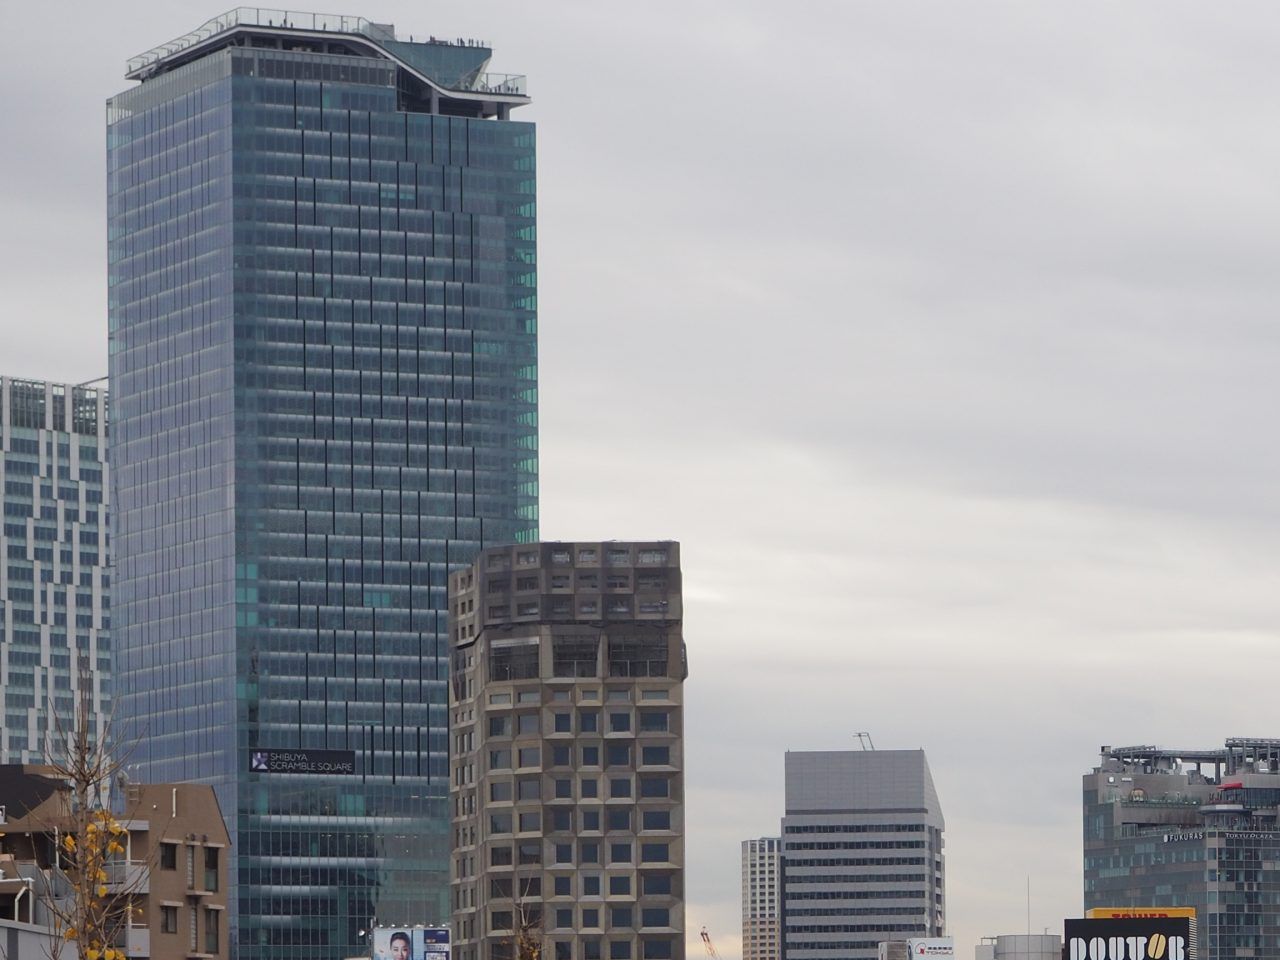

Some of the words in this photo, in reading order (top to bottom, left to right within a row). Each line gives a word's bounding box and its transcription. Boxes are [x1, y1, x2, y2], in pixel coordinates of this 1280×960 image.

[270, 753, 307, 761] SHIBUYA
[270, 761, 315, 770] SCRAMBLE
[317, 762, 352, 771] SQUARE
[1170, 833, 1203, 841] FUKURAS
